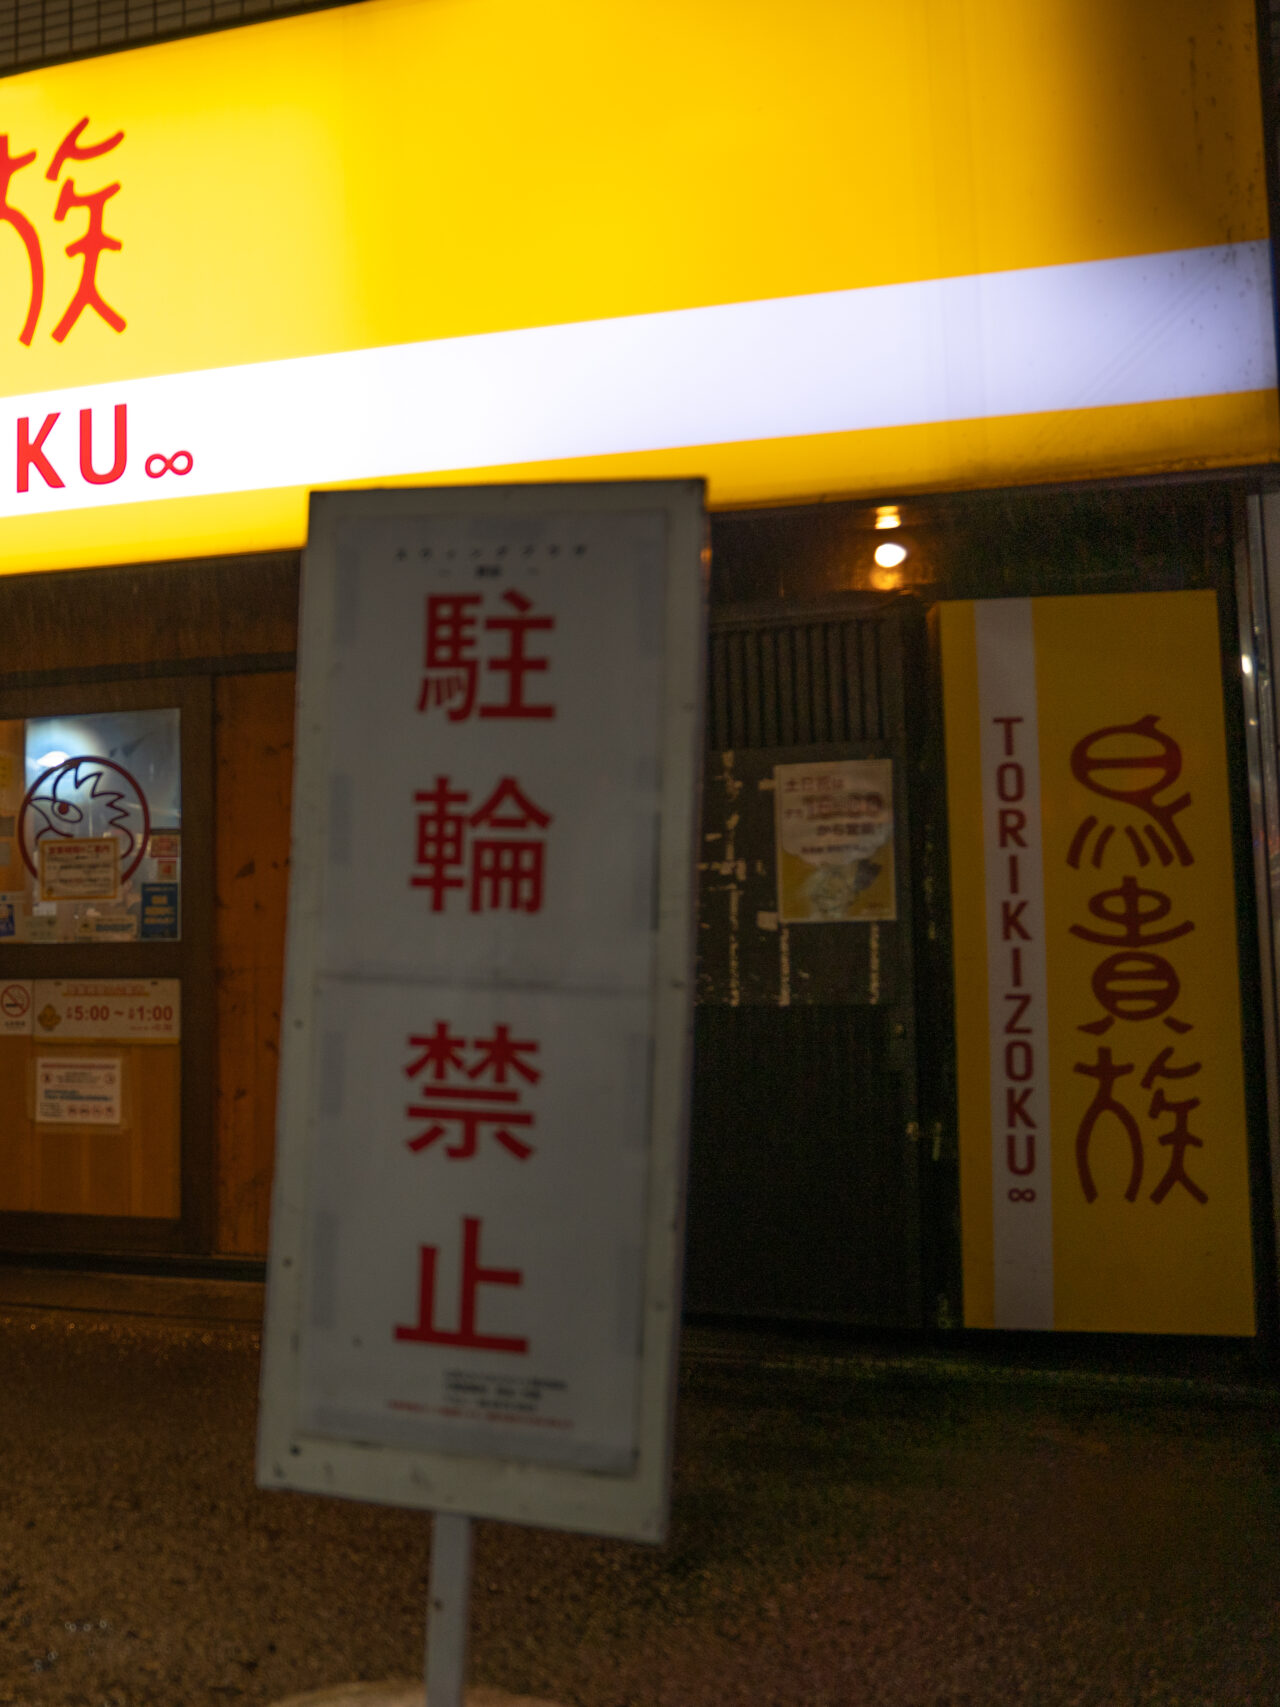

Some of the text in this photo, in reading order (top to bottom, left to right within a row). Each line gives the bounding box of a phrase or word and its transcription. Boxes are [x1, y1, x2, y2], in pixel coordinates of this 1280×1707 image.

[393, 589, 556, 1356] 駐輪禁止
[992, 717, 1036, 1177] TORIKIZOKU
